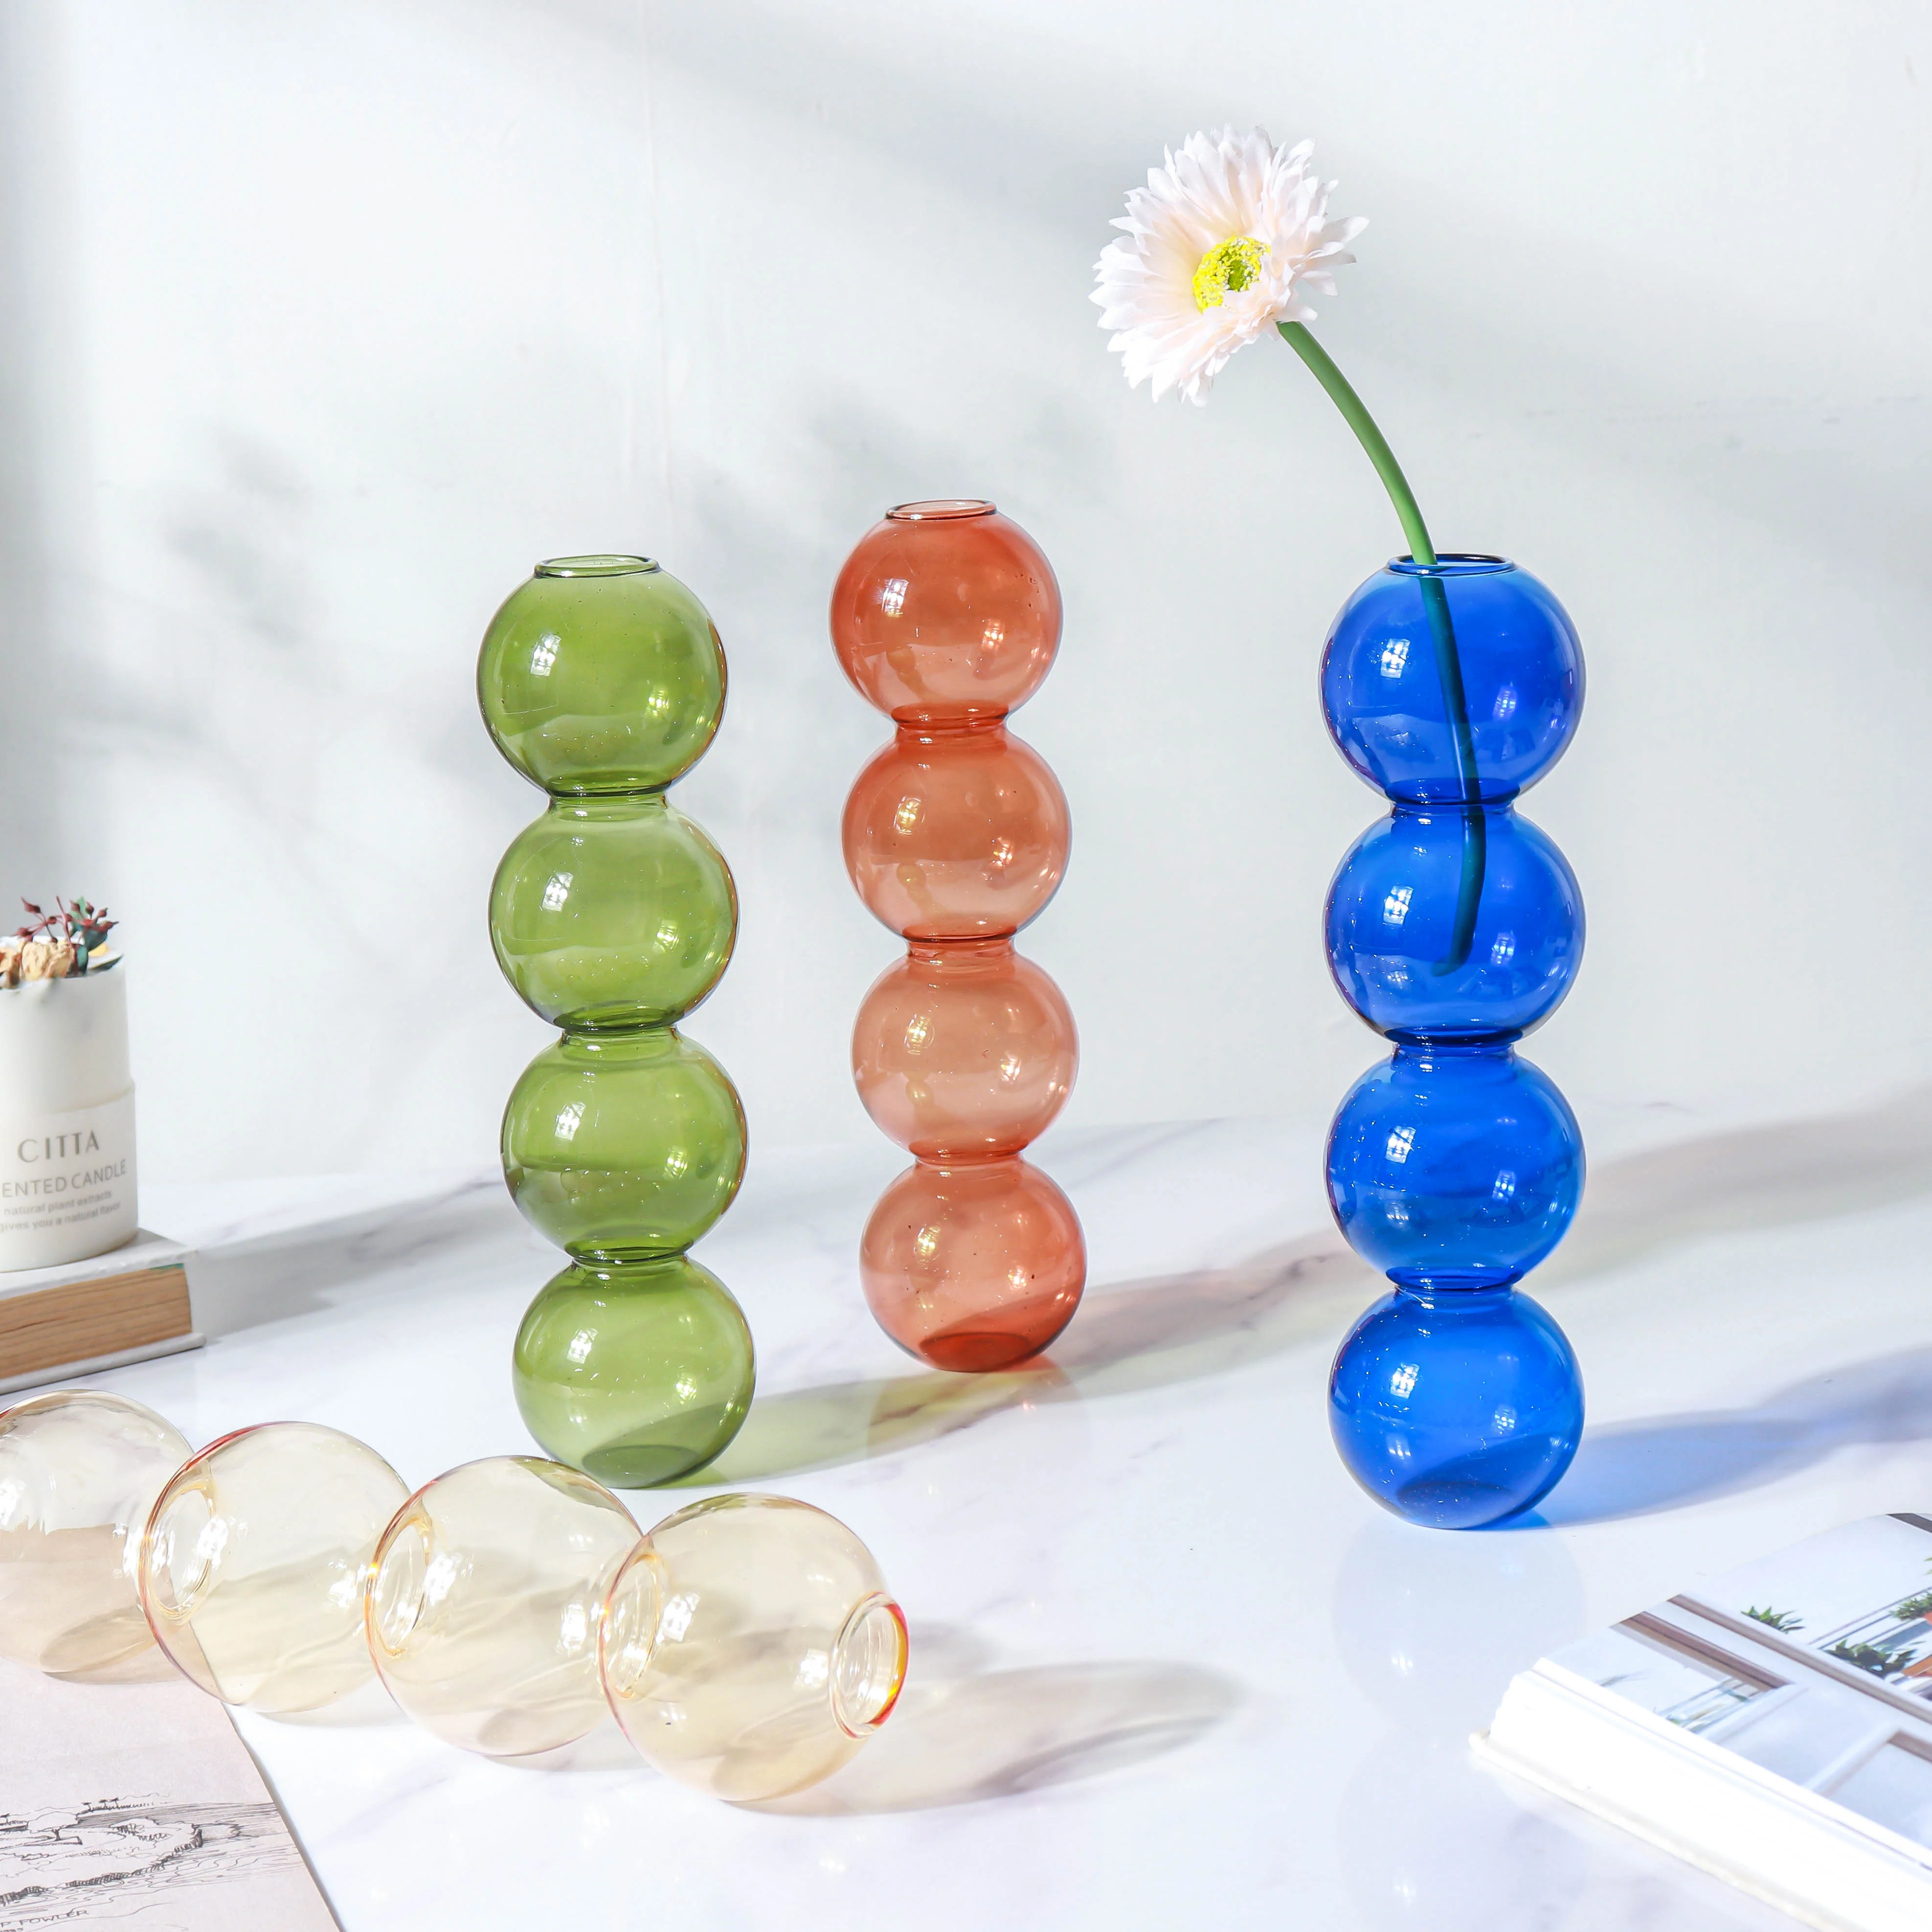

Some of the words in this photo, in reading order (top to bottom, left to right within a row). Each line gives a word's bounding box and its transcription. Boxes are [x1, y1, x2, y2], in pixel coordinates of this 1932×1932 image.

[17, 1130, 99, 1163] CITTA
[2, 1177, 67, 1197] ENTED
[71, 1159, 126, 1189] CANDLE
[4, 1203, 45, 1215] natural
[48, 1199, 74, 1213] plant
[32, 1219, 52, 1230] you
[65, 1209, 98, 1222] natural
[20, 1910, 89, 1925] FOWLER
